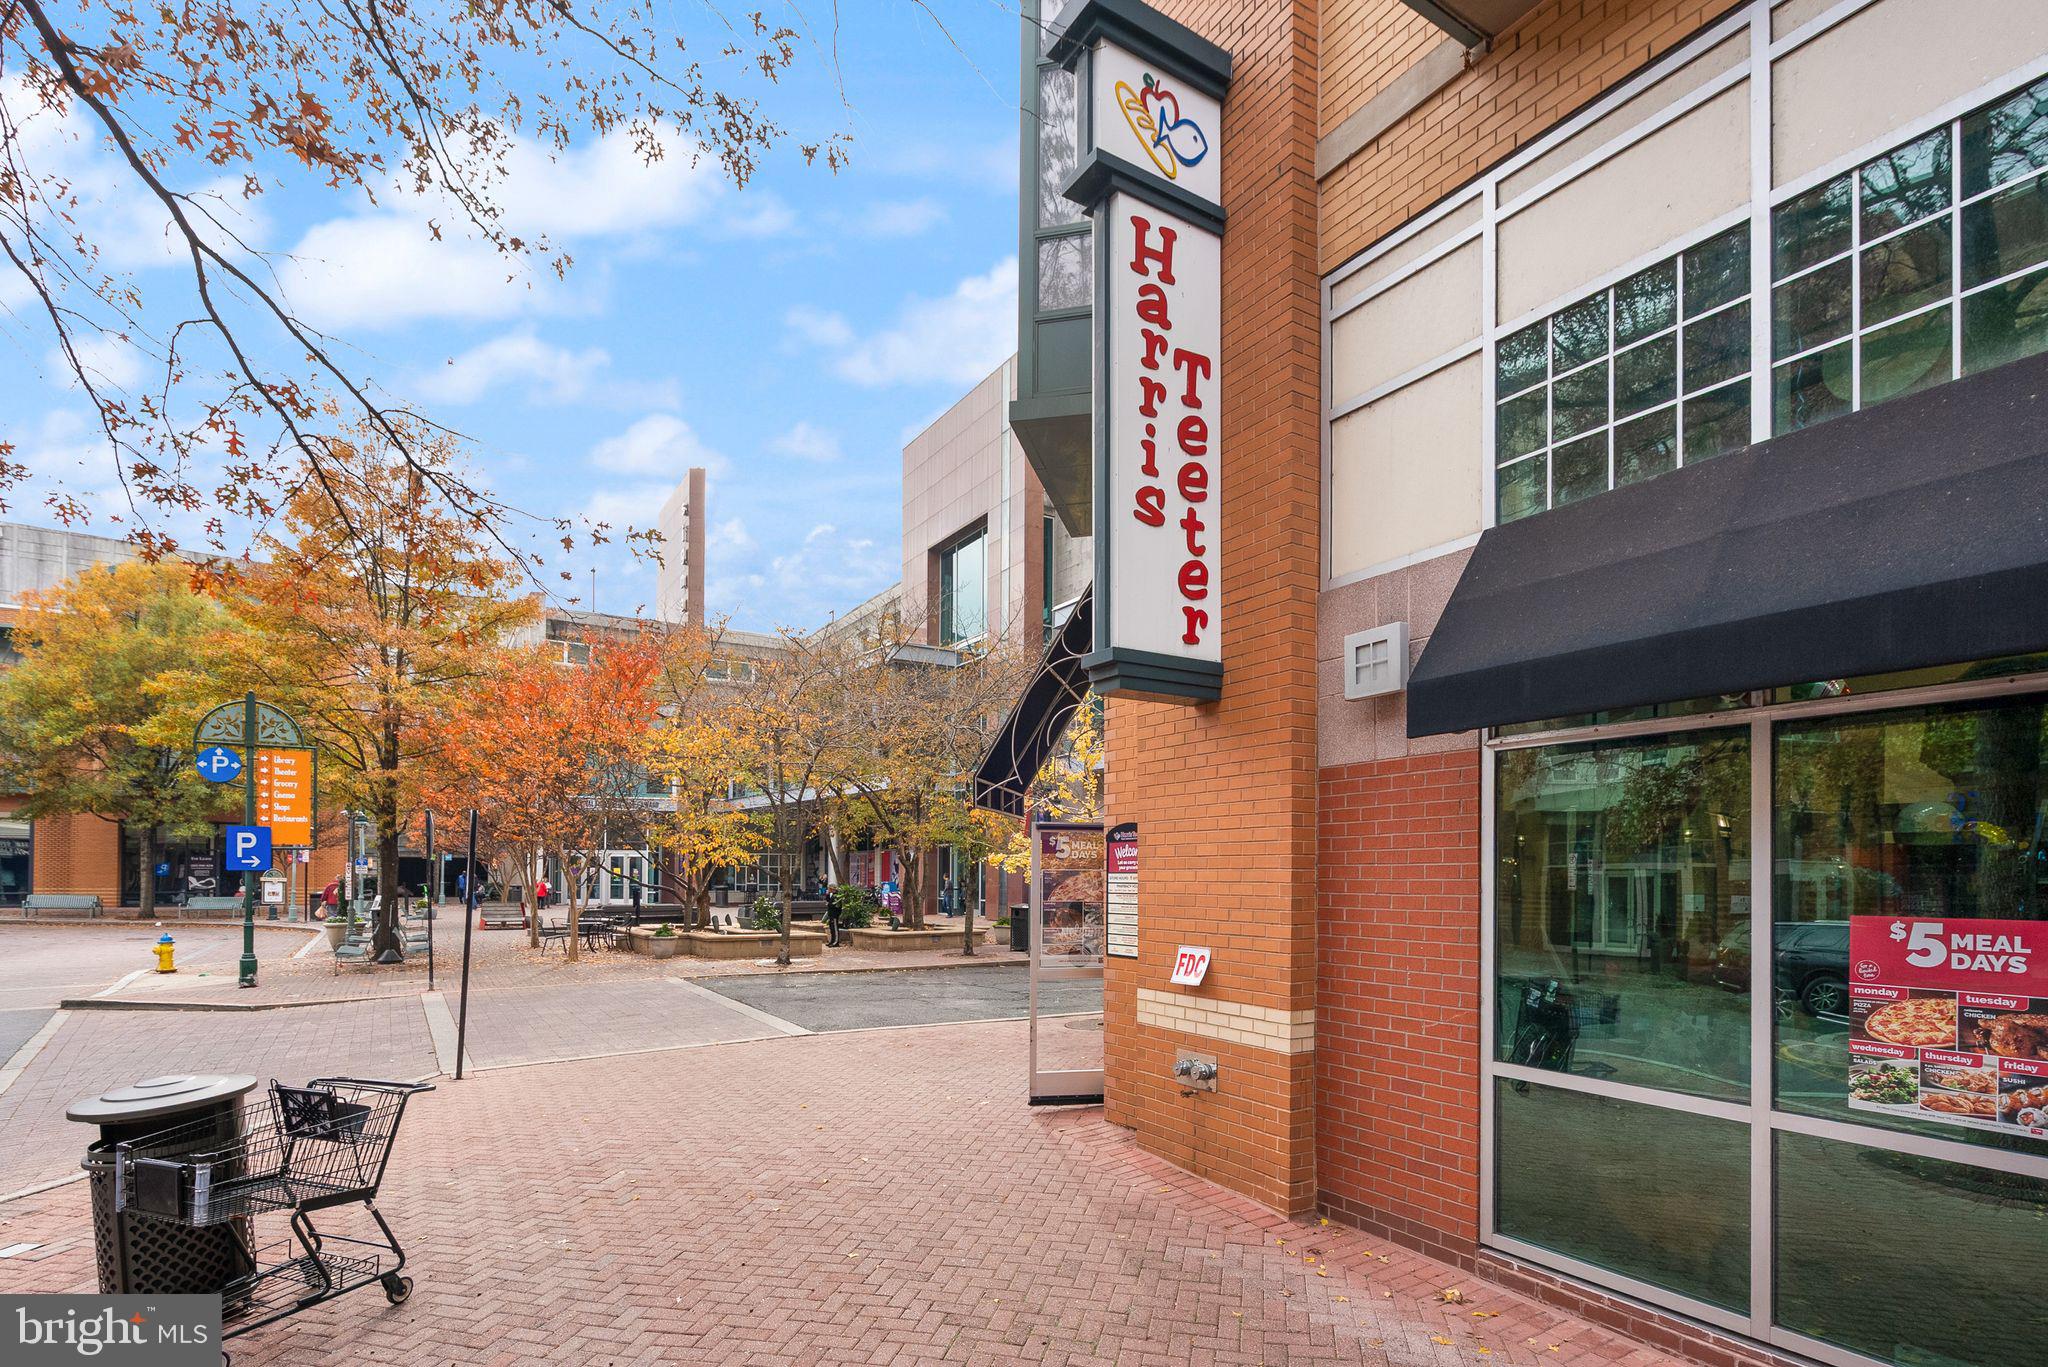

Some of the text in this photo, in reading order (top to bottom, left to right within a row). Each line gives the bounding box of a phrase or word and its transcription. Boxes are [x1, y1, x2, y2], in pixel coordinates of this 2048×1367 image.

[1130, 216, 1178, 528] Harris
[1173, 348, 1211, 645] Teeter
[212, 756, 229, 774] P
[273, 755, 296, 766] Library
[274, 767, 297, 776] Theater
[273, 779, 299, 790] Grocery
[273, 791, 296, 799] Cinema
[273, 802, 291, 811] Shops
[273, 814, 308, 823] Restaurants
[236, 832, 257, 858] P
[1048, 836, 1099, 859] $5 MEAL
[1071, 850, 1098, 859] DAYS
[1889, 920, 2031, 968] $5 MEAL
[1175, 952, 1207, 978] FDC
[1951, 953, 2028, 974] DAYS
[1854, 987, 1898, 998] monday
[1965, 995, 2017, 1008] tuesday
[1963, 1012, 1996, 1020] CHICKEN
[1852, 1043, 1905, 1057] wednesday
[1853, 1058, 1877, 1066] SALADS
[1924, 1052, 1973, 1065] thursday
[1924, 1067, 1956, 1076] CHICKEN
[2003, 1061, 2039, 1073] friday
[2002, 1077, 2026, 1085] SUSHI
